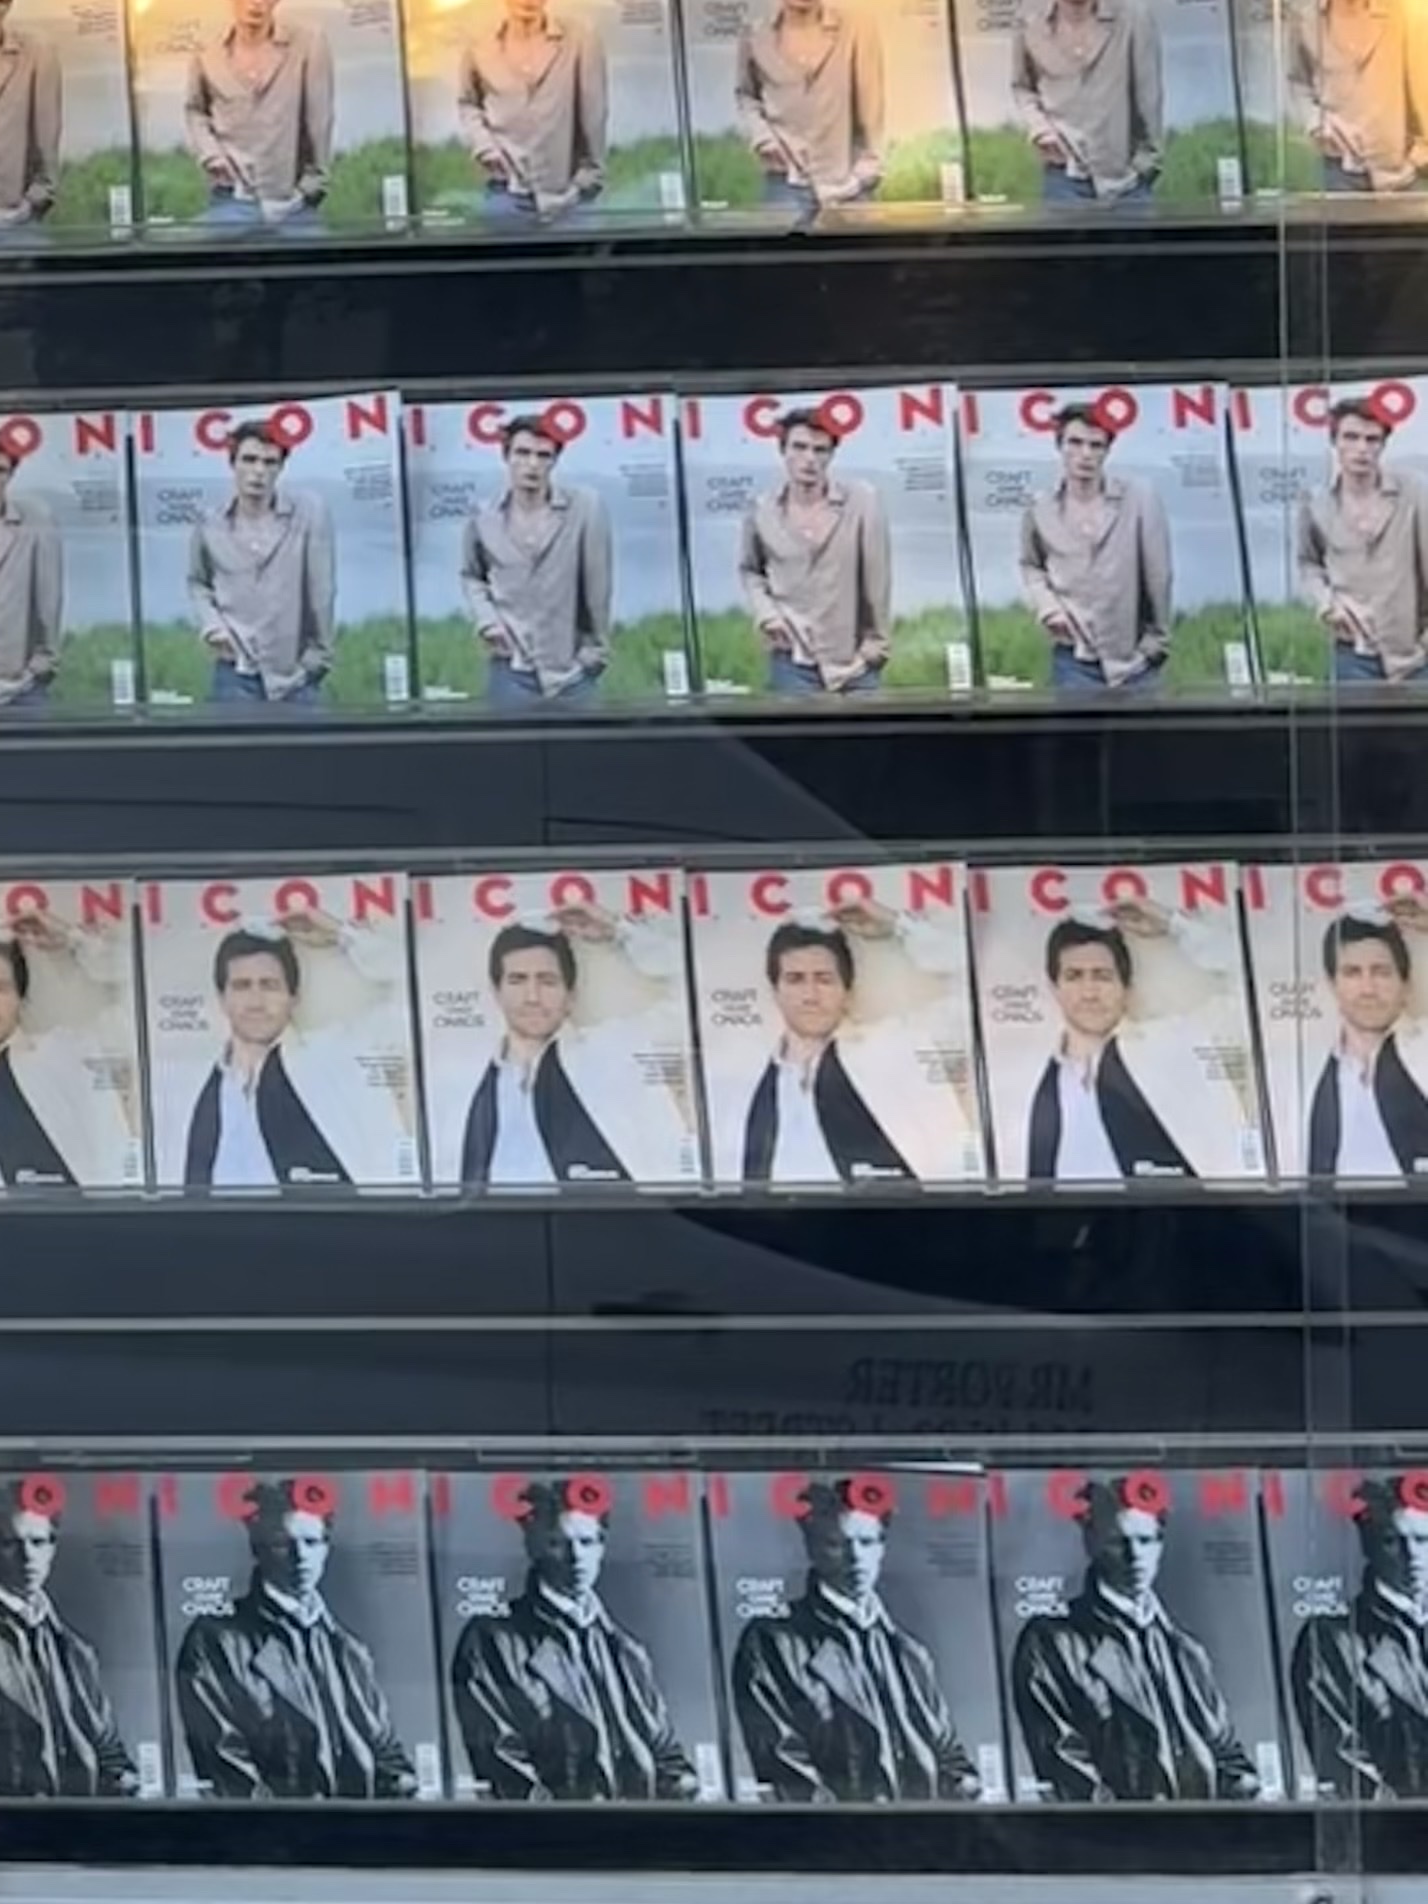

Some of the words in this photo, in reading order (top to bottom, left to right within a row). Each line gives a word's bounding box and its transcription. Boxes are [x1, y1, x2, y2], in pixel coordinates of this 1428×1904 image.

[140, 394, 387, 454] ICON
[410, 396, 664, 448] ICON
[686, 387, 944, 439] ICON
[960, 386, 1215, 434] ICON
[147, 876, 398, 925] ICON
[417, 873, 672, 919] ICON
[693, 868, 956, 916] ICON
[975, 867, 1224, 913] ICON
[159, 1472, 418, 1519] ICON
[435, 1472, 692, 1519] ICON
[708, 1472, 978, 1518] ICON
[987, 1470, 1250, 1518] ICON
